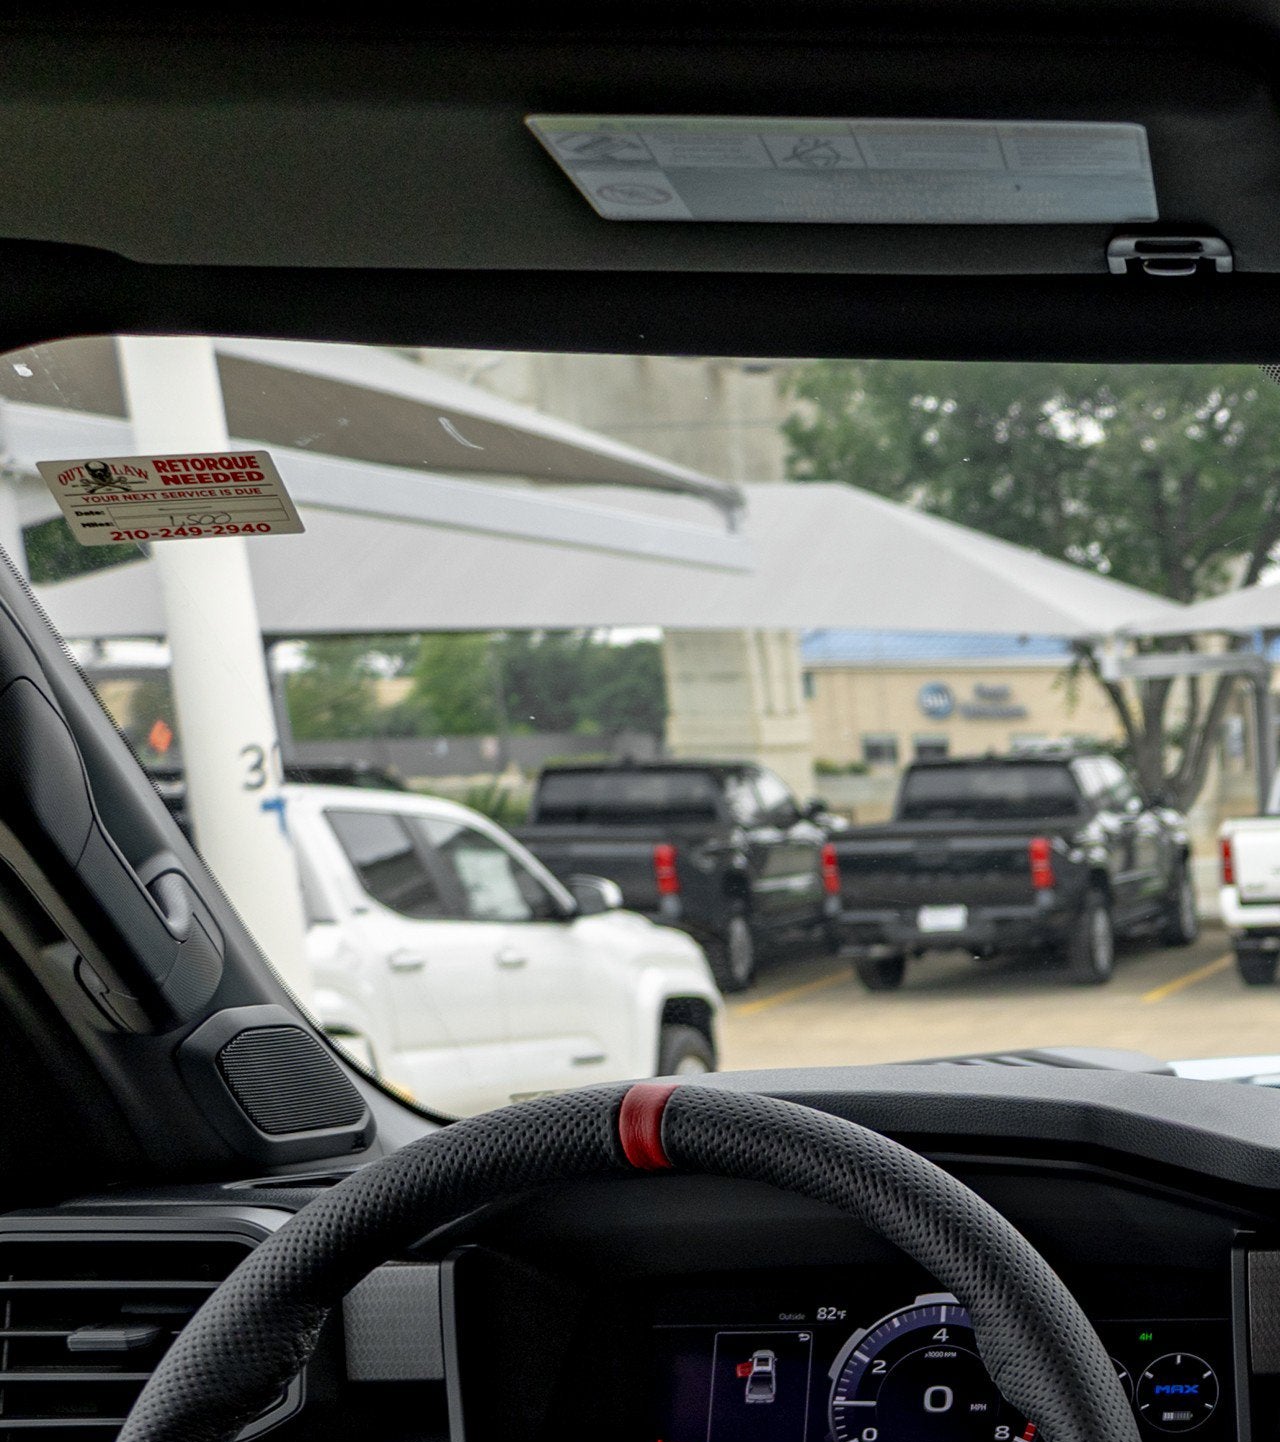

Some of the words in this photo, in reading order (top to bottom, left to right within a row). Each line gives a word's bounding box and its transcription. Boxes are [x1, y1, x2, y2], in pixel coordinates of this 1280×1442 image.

[152, 455, 260, 474] RETORQUE
[161, 471, 265, 486] NEEDED
[82, 495, 121, 505] YOUR
[123, 492, 157, 502] NEXT
[160, 489, 215, 499] SERVICE
[219, 488, 231, 497] IS
[235, 487, 262, 496] DUE
[110, 522, 272, 542] 210-249-2940
[932, 1327, 950, 1342] 4
[1139, 1332, 1153, 1341] 4H
[872, 1360, 887, 1374] 2
[1154, 1384, 1199, 1395] MAX
[923, 1385, 953, 1413] 0
[970, 1402, 987, 1412] MPH
[862, 1427, 878, 1442] 0
[994, 1425, 1010, 1440] 8
